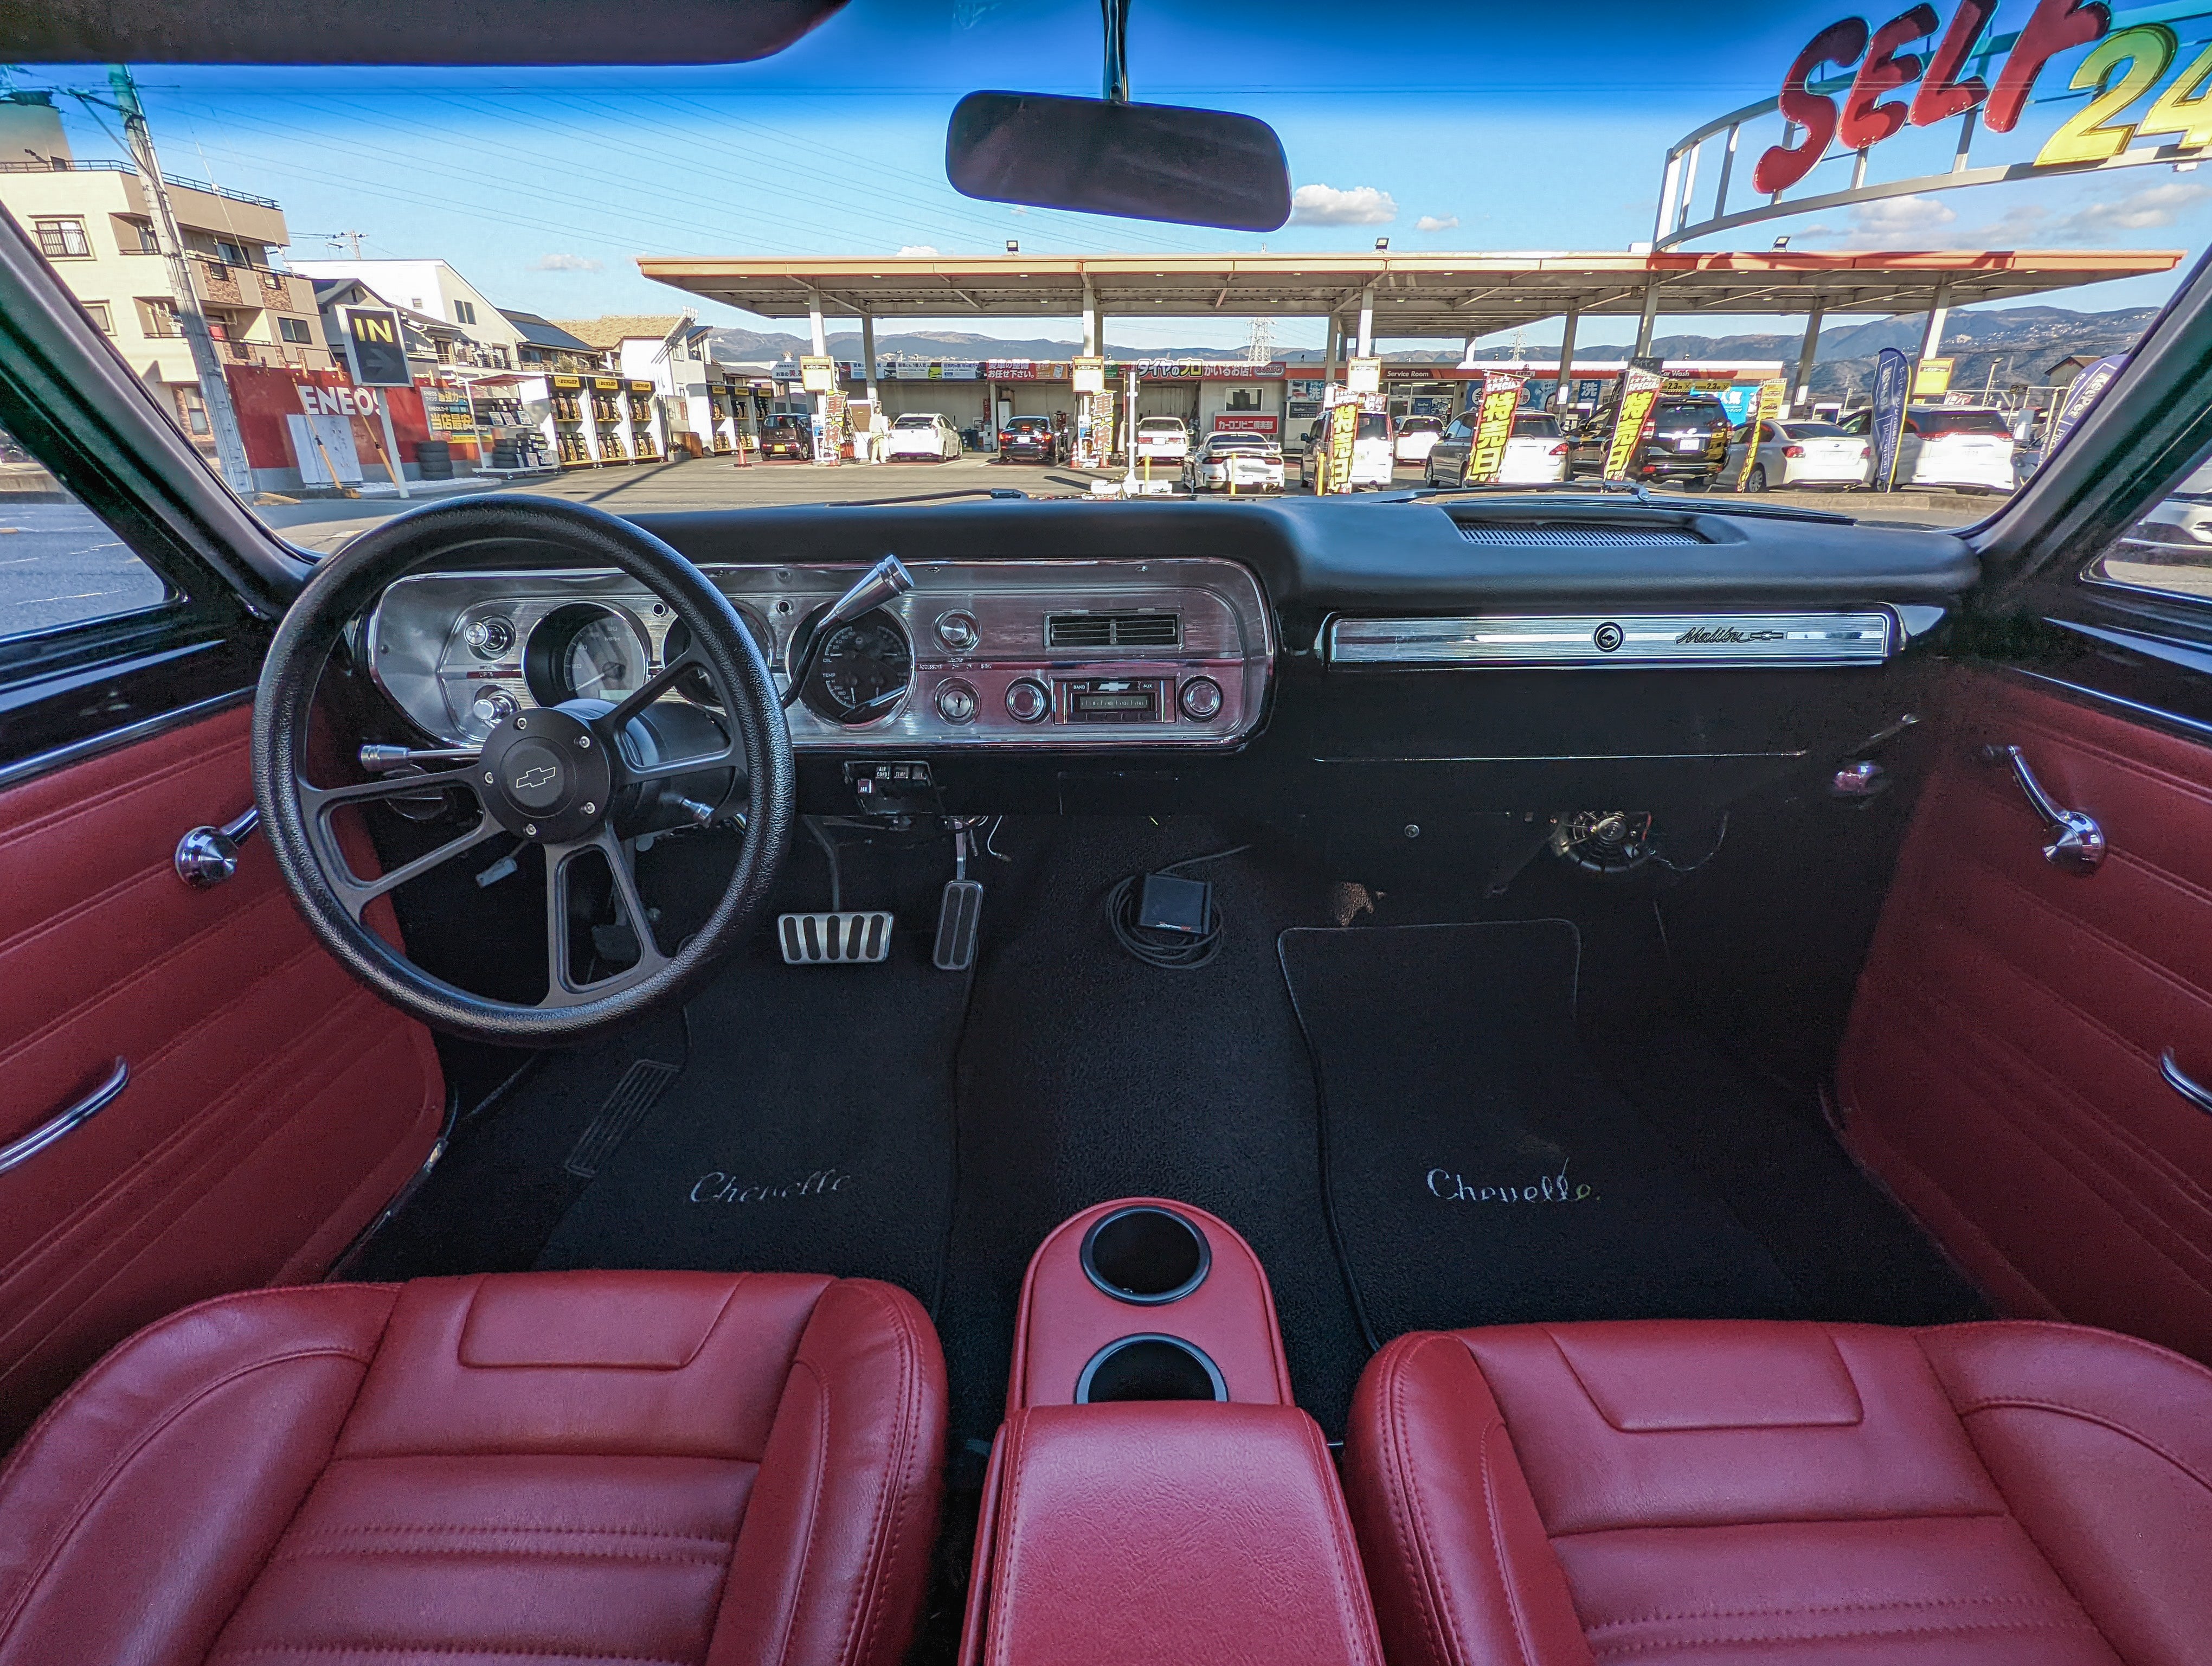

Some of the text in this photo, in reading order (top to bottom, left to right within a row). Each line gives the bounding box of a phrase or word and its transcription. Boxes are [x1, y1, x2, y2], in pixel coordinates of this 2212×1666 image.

[2033, 22, 2212, 167] 24
[354, 318, 393, 343] IN
[988, 370, 1034, 379] お任せ下さい。
[1333, 404, 1356, 484] 特売日
[1472, 391, 1516, 475] 特売日
[1606, 391, 1654, 472] 特売日
[1676, 626, 1754, 644] Malibu
